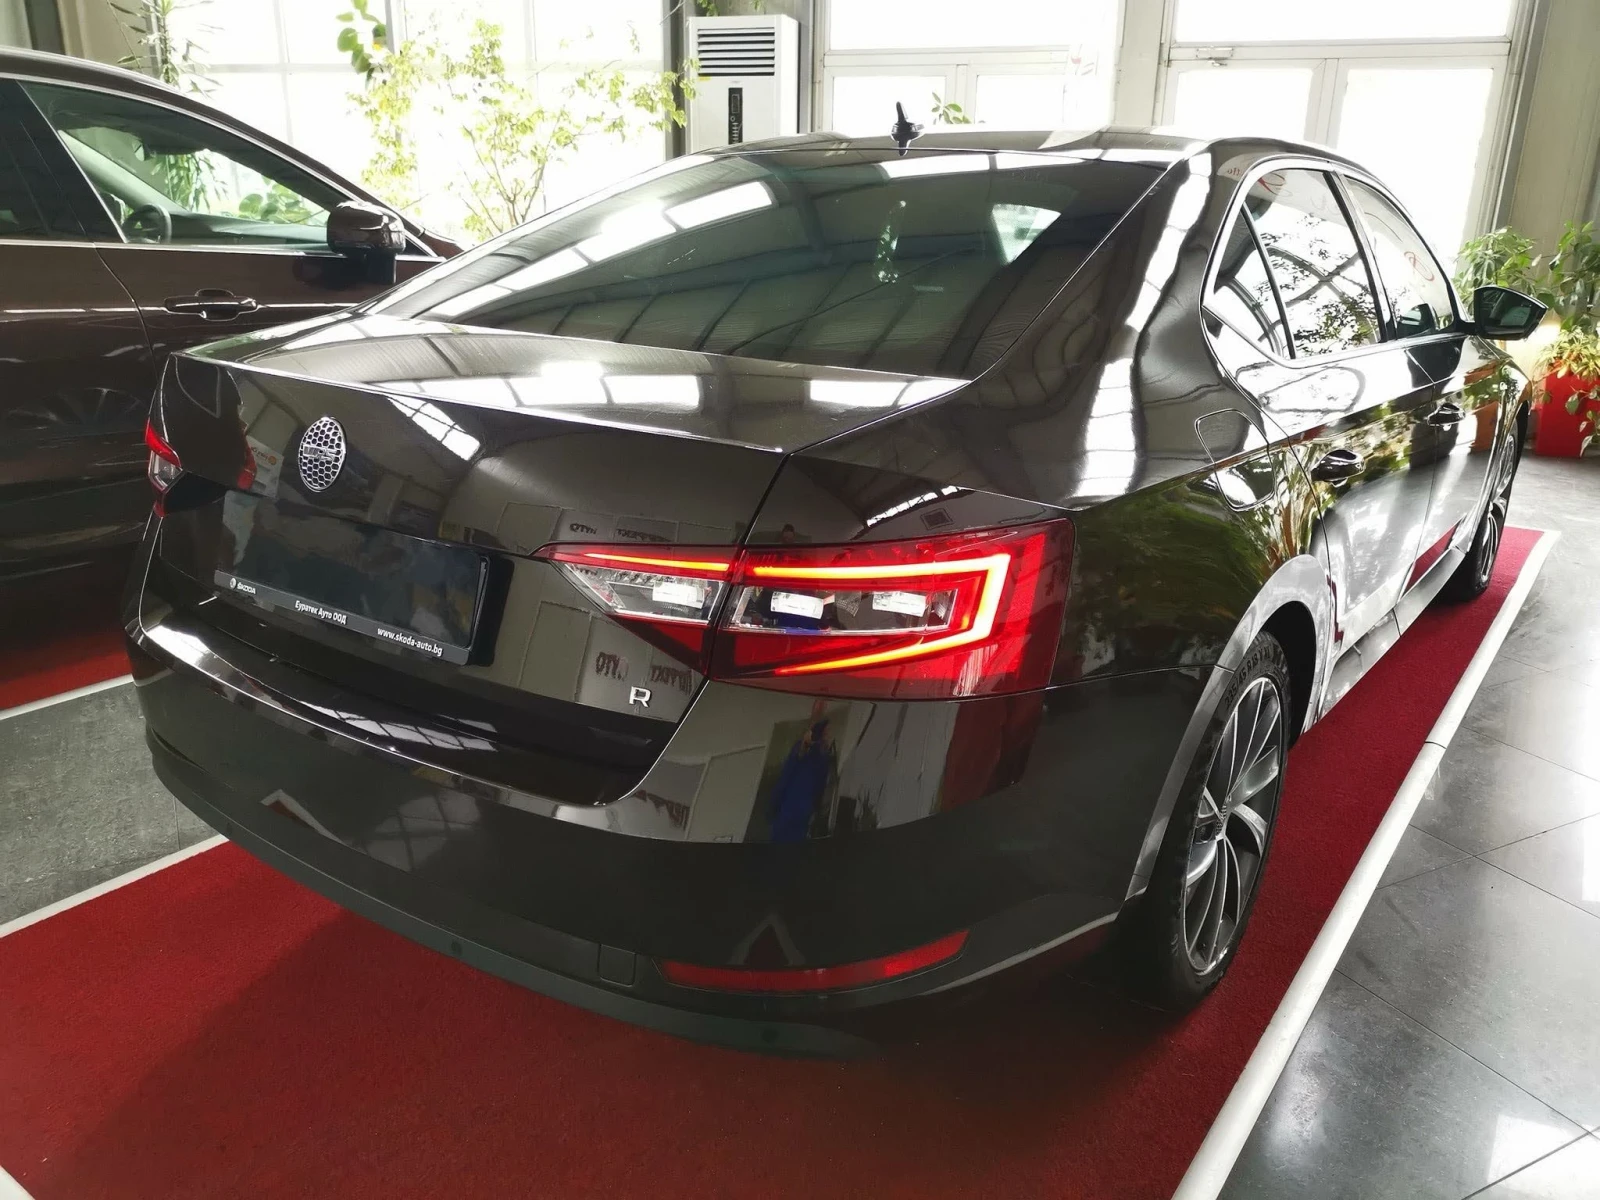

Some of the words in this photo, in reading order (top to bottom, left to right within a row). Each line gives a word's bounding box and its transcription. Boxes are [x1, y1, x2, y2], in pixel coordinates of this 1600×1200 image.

[294, 599, 319, 615] Еуратек
[317, 607, 333, 619] Ауто
[332, 611, 348, 625] ООД
[377, 628, 443, 657] www.skoda-auto.bg
[629, 686, 652, 708] R
